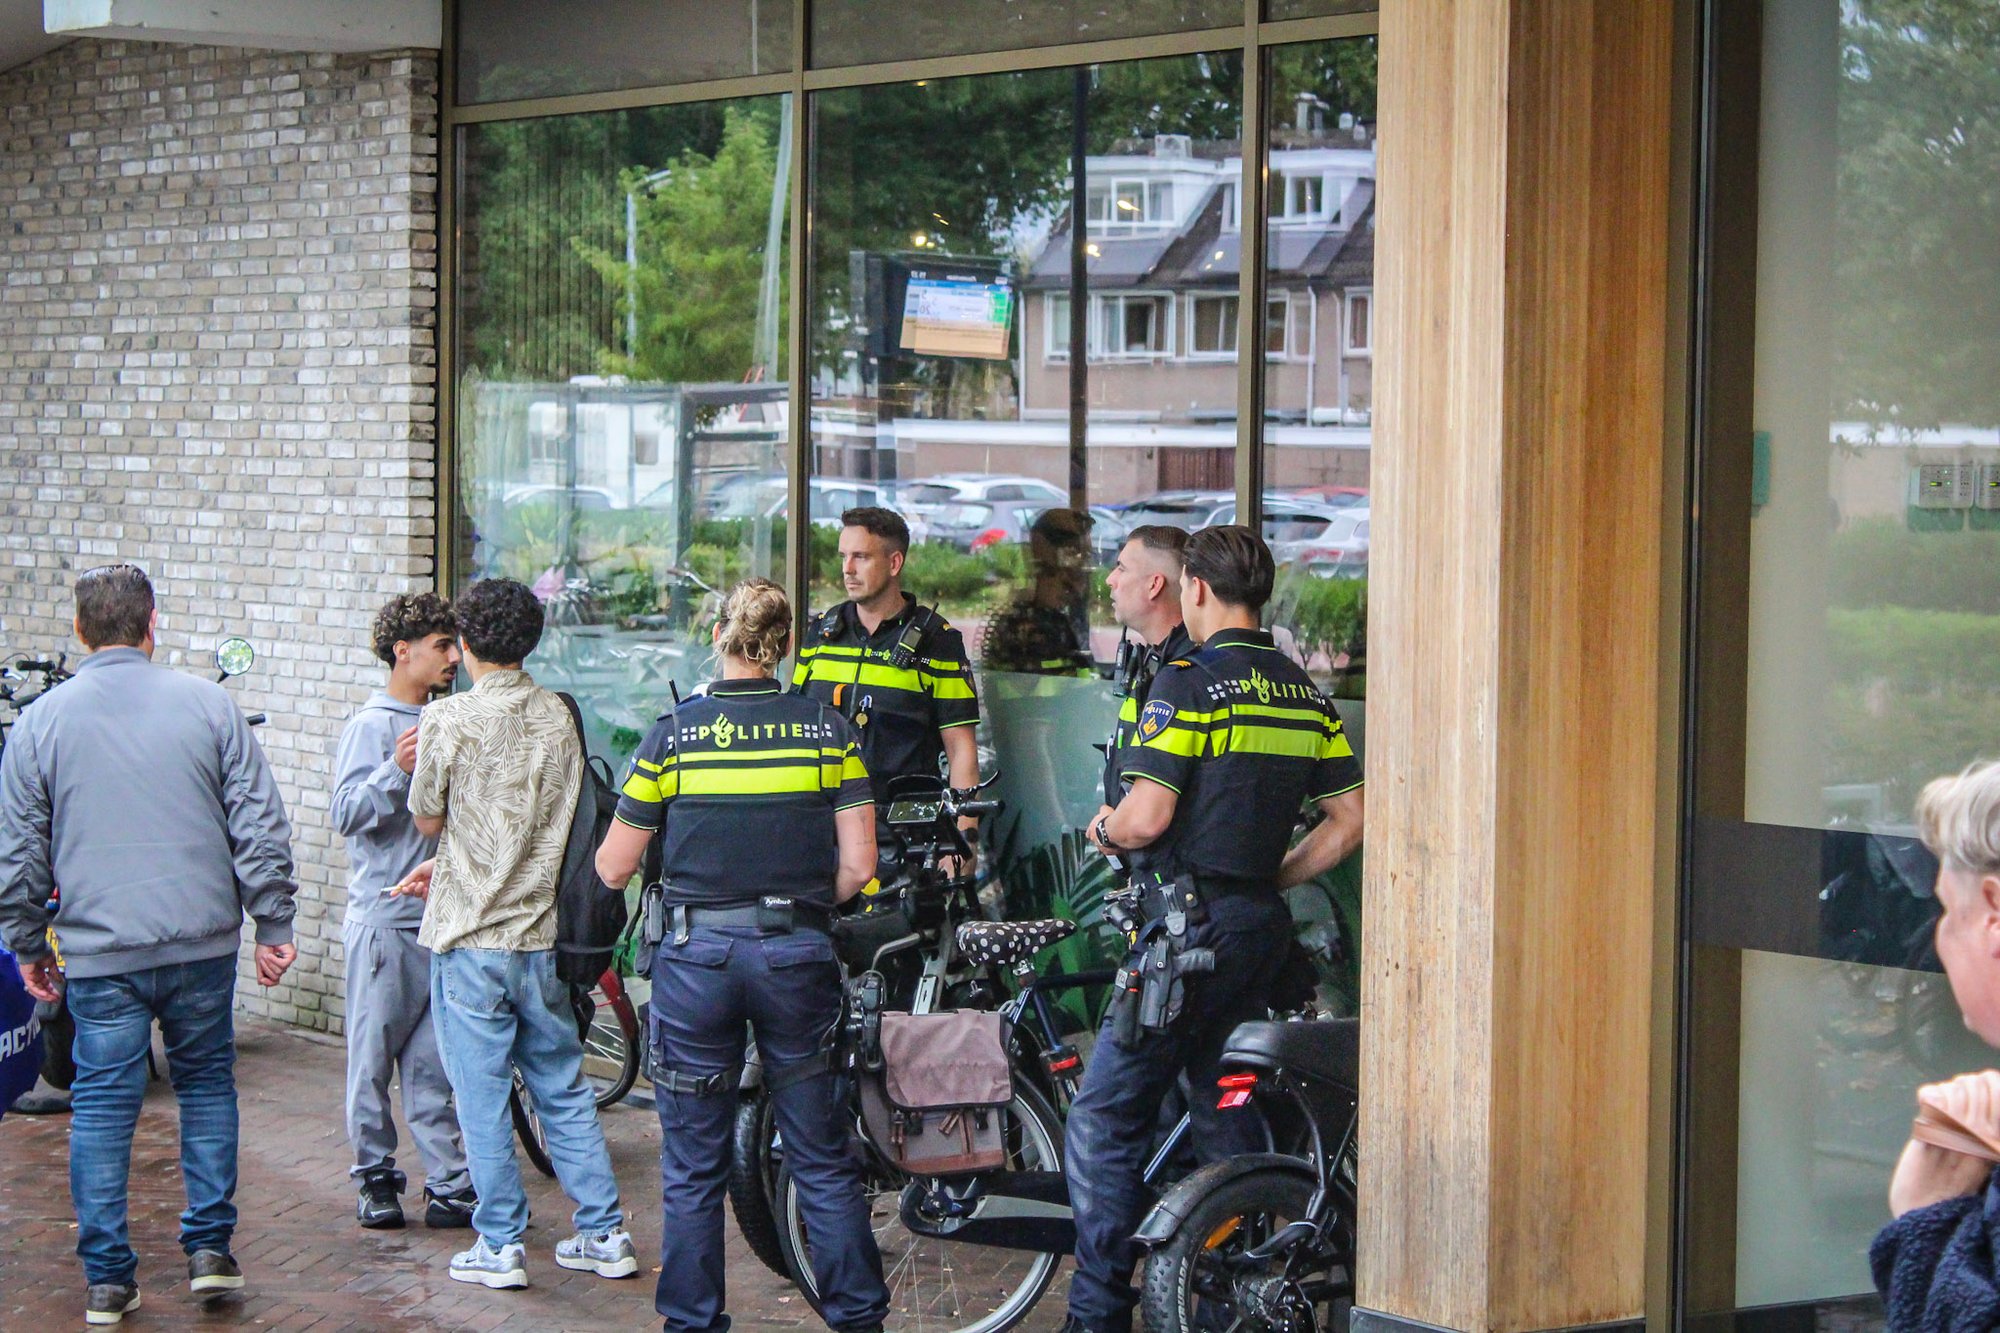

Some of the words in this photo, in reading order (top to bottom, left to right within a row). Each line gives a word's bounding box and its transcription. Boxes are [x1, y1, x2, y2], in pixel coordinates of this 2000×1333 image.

[1239, 672, 1315, 704] POLITIE
[1145, 704, 1171, 717] POLITIE
[699, 718, 803, 748] POLITIE
